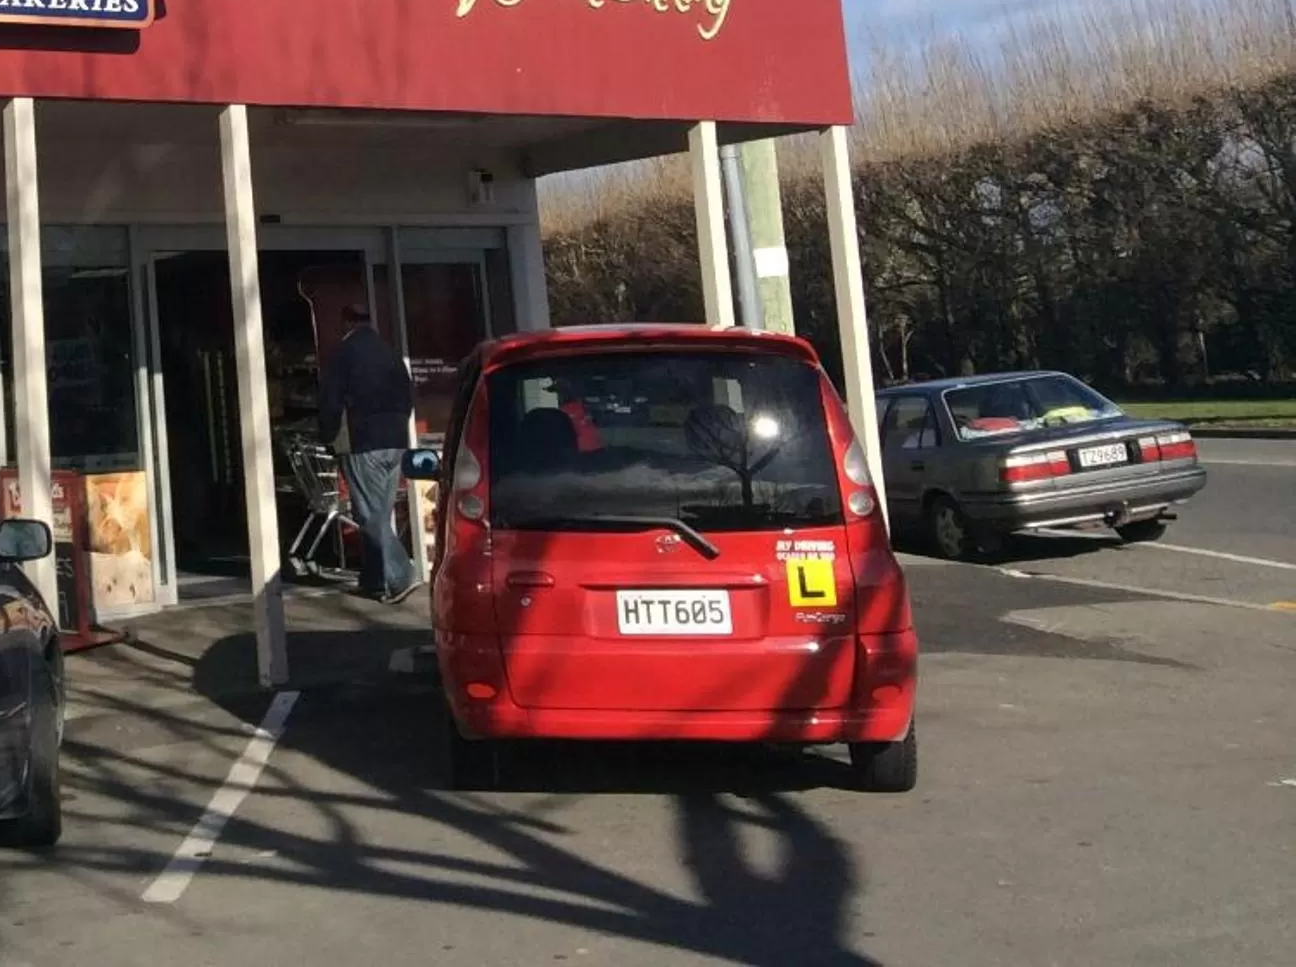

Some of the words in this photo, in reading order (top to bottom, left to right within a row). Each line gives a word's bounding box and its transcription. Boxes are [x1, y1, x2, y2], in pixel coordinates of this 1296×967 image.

[1082, 445, 1125, 464] TZ9689
[797, 566, 825, 598] L
[623, 599, 724, 625] HTT605
